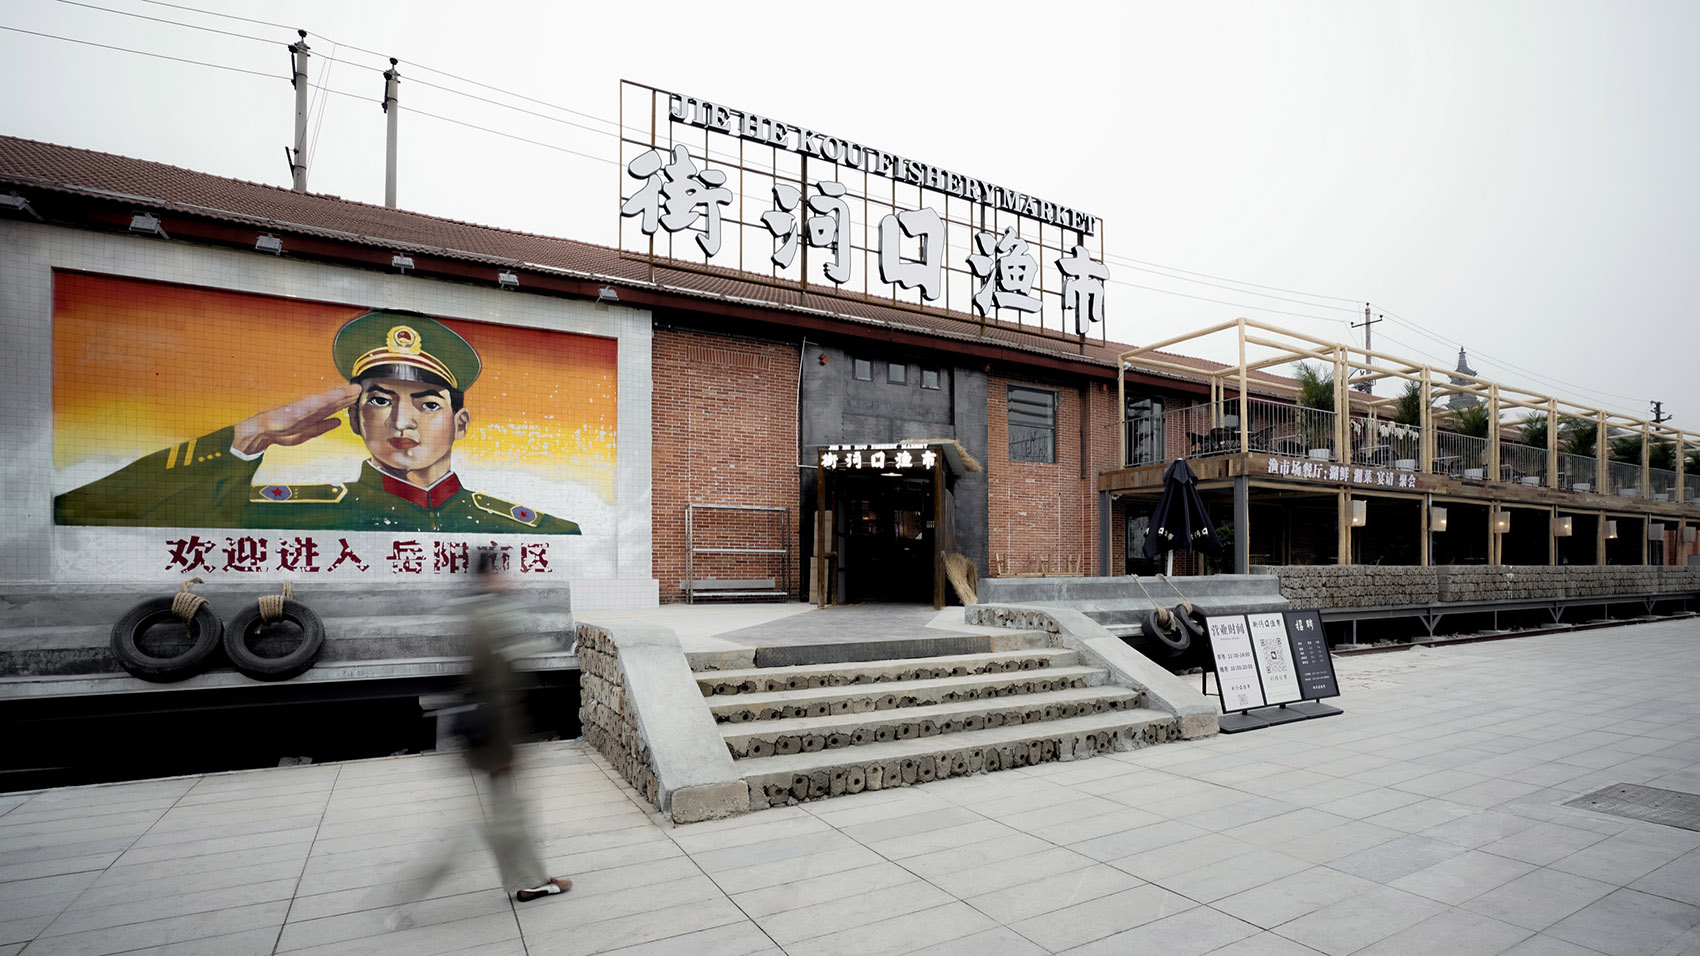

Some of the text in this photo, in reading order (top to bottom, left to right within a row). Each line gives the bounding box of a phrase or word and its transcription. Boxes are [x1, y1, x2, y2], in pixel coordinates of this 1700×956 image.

[669, 92, 1097, 236] JIE HE KOU FISHERY MARKET
[621, 144, 1110, 335] 街河口渔市
[821, 450, 937, 470] 街河口渔市
[1353, 467, 1373, 485] 湘菜
[1211, 623, 1245, 636] 营业时间
[1295, 618, 1314, 631] 招聘
